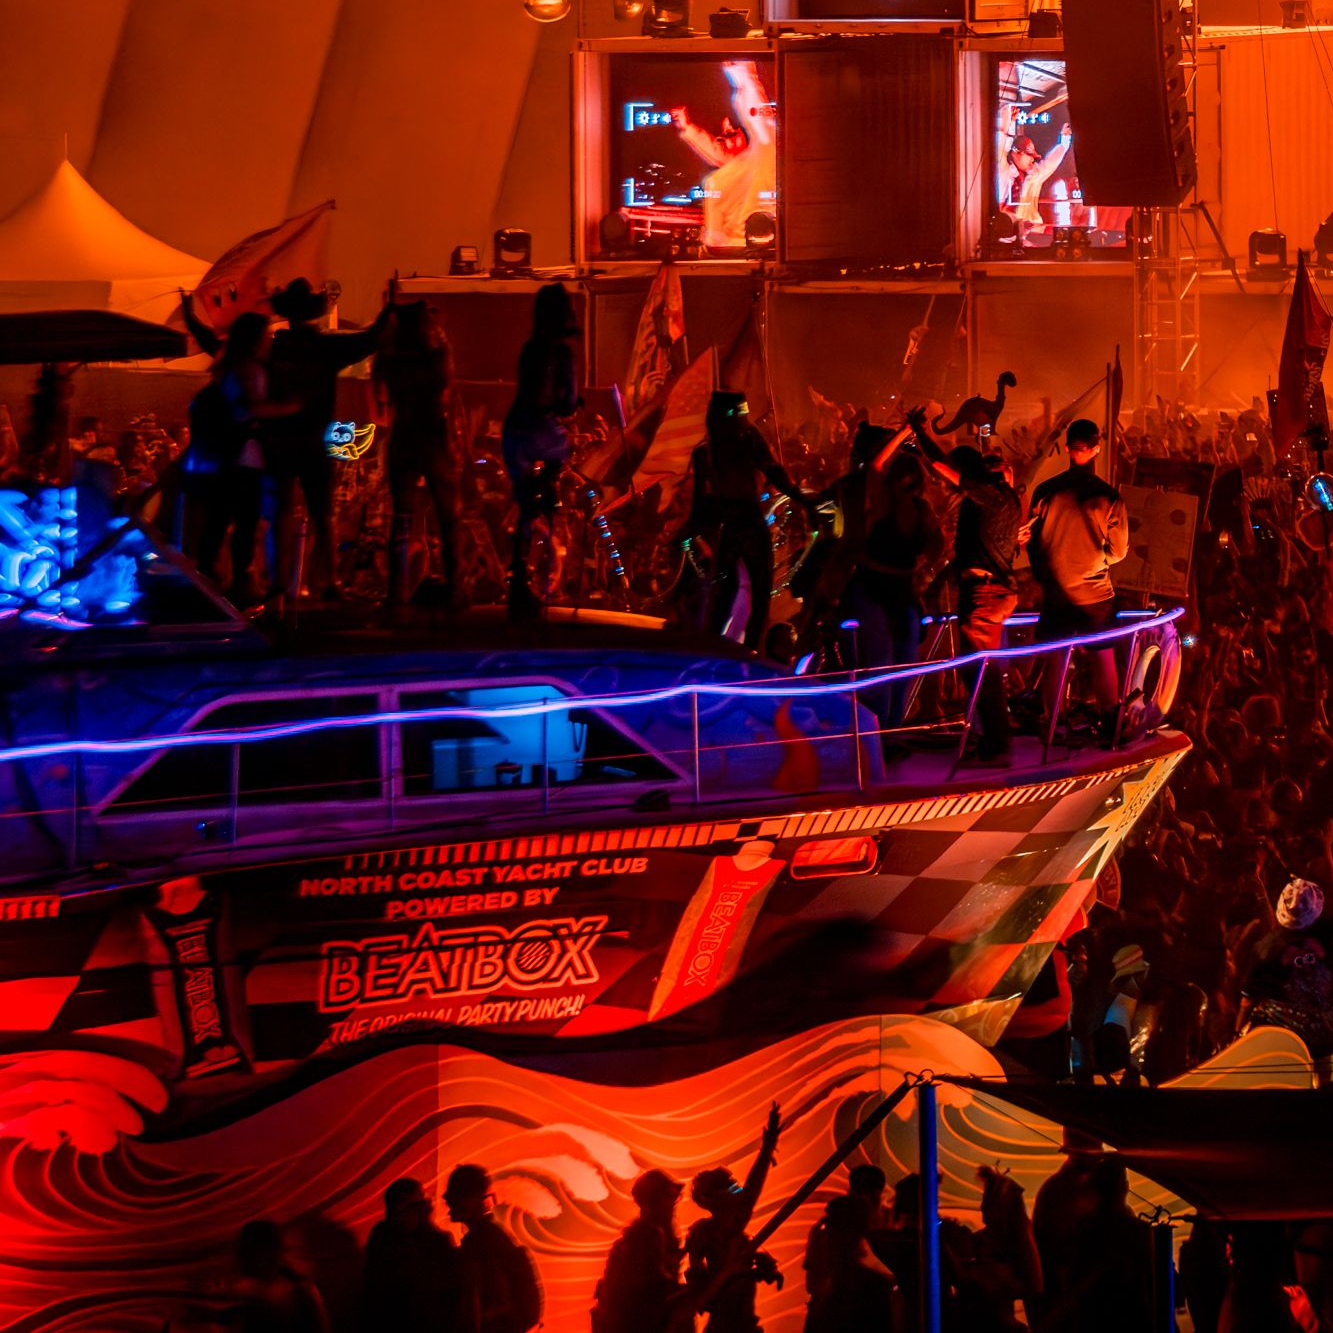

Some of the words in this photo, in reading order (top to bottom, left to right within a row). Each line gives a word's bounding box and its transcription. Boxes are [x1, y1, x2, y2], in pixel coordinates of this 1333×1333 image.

[299, 875, 393, 897] NORTH
[400, 868, 488, 891] COAST
[493, 860, 578, 883] YACHT
[580, 857, 649, 877] CLUB
[385, 890, 519, 920] POWERED
[523, 886, 560, 907] BY
[319, 914, 609, 1013] BEATBOX
[683, 891, 744, 987] BEATBOX
[328, 1017, 371, 1045] THE
[456, 1002, 519, 1026] PARTY
[519, 993, 586, 1021] PUNCH!
